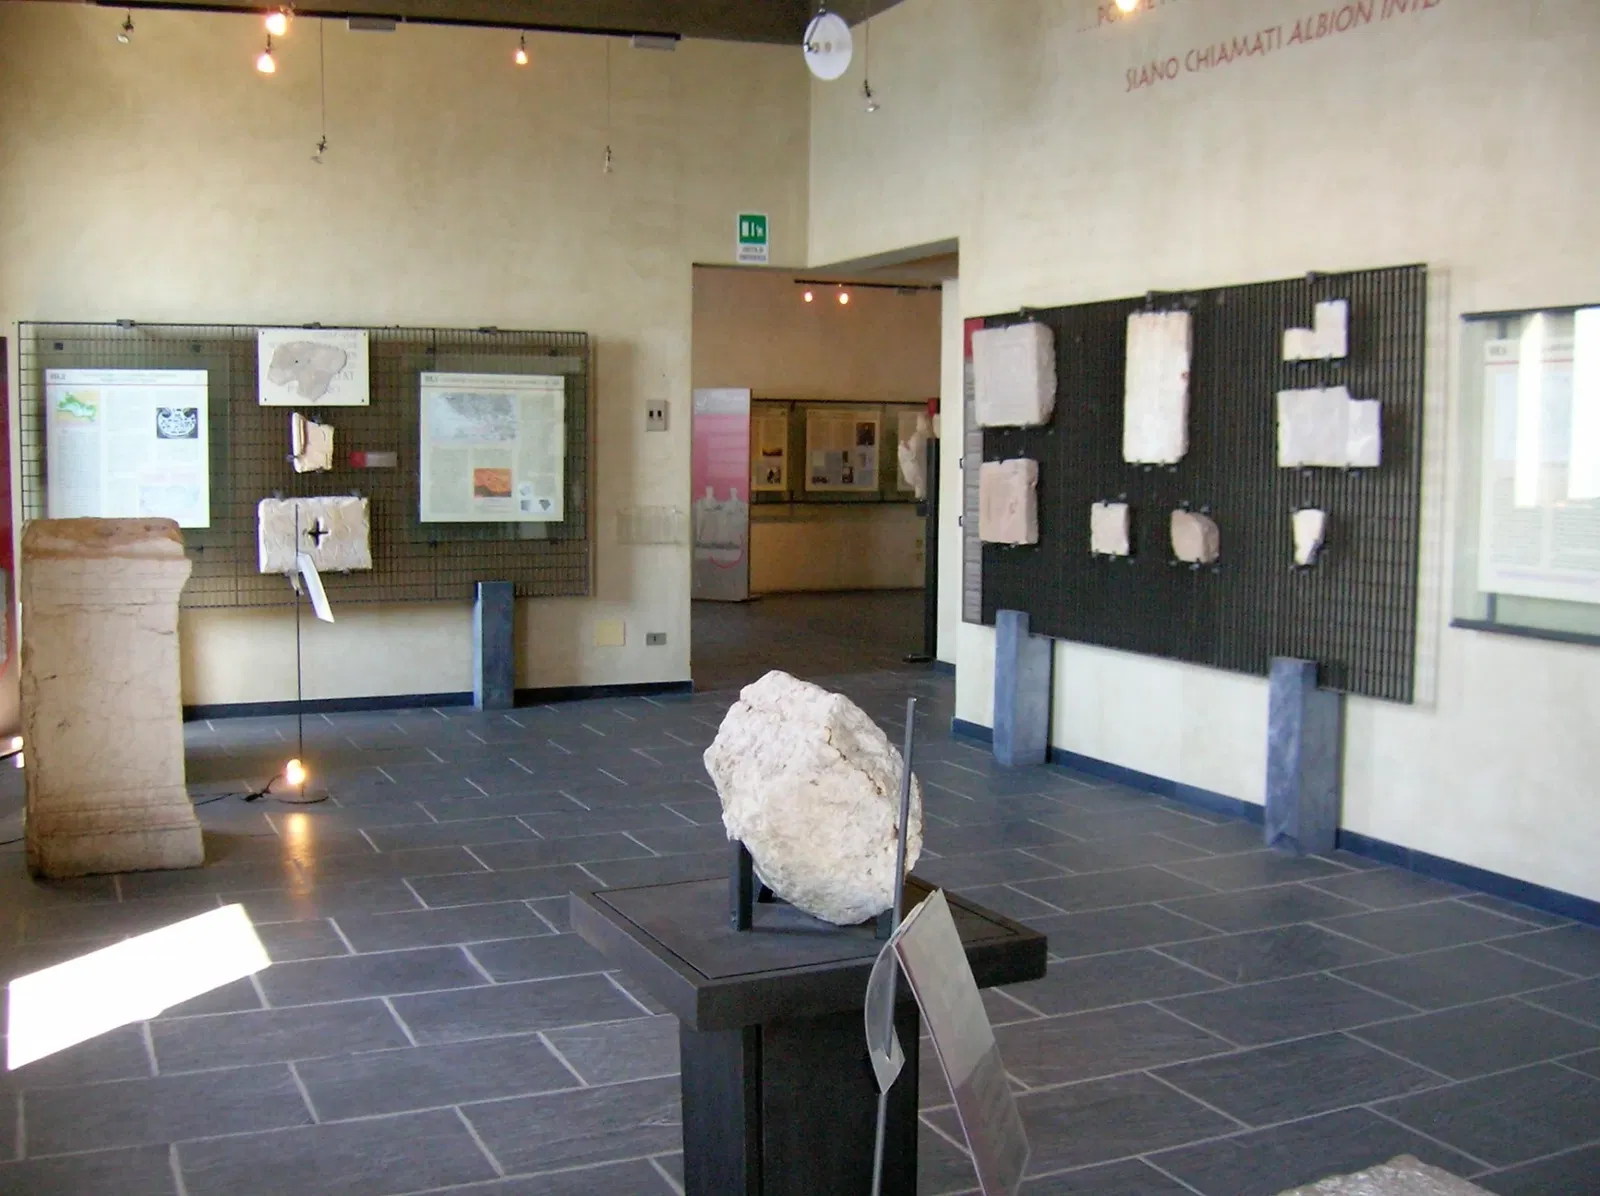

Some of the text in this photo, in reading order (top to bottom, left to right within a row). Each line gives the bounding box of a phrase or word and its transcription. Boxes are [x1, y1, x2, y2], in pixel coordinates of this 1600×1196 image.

[1125, 56, 1180, 93] SIANO
[1184, 24, 1283, 73] CHIAMATI
[1286, 0, 1374, 46] ALBION
